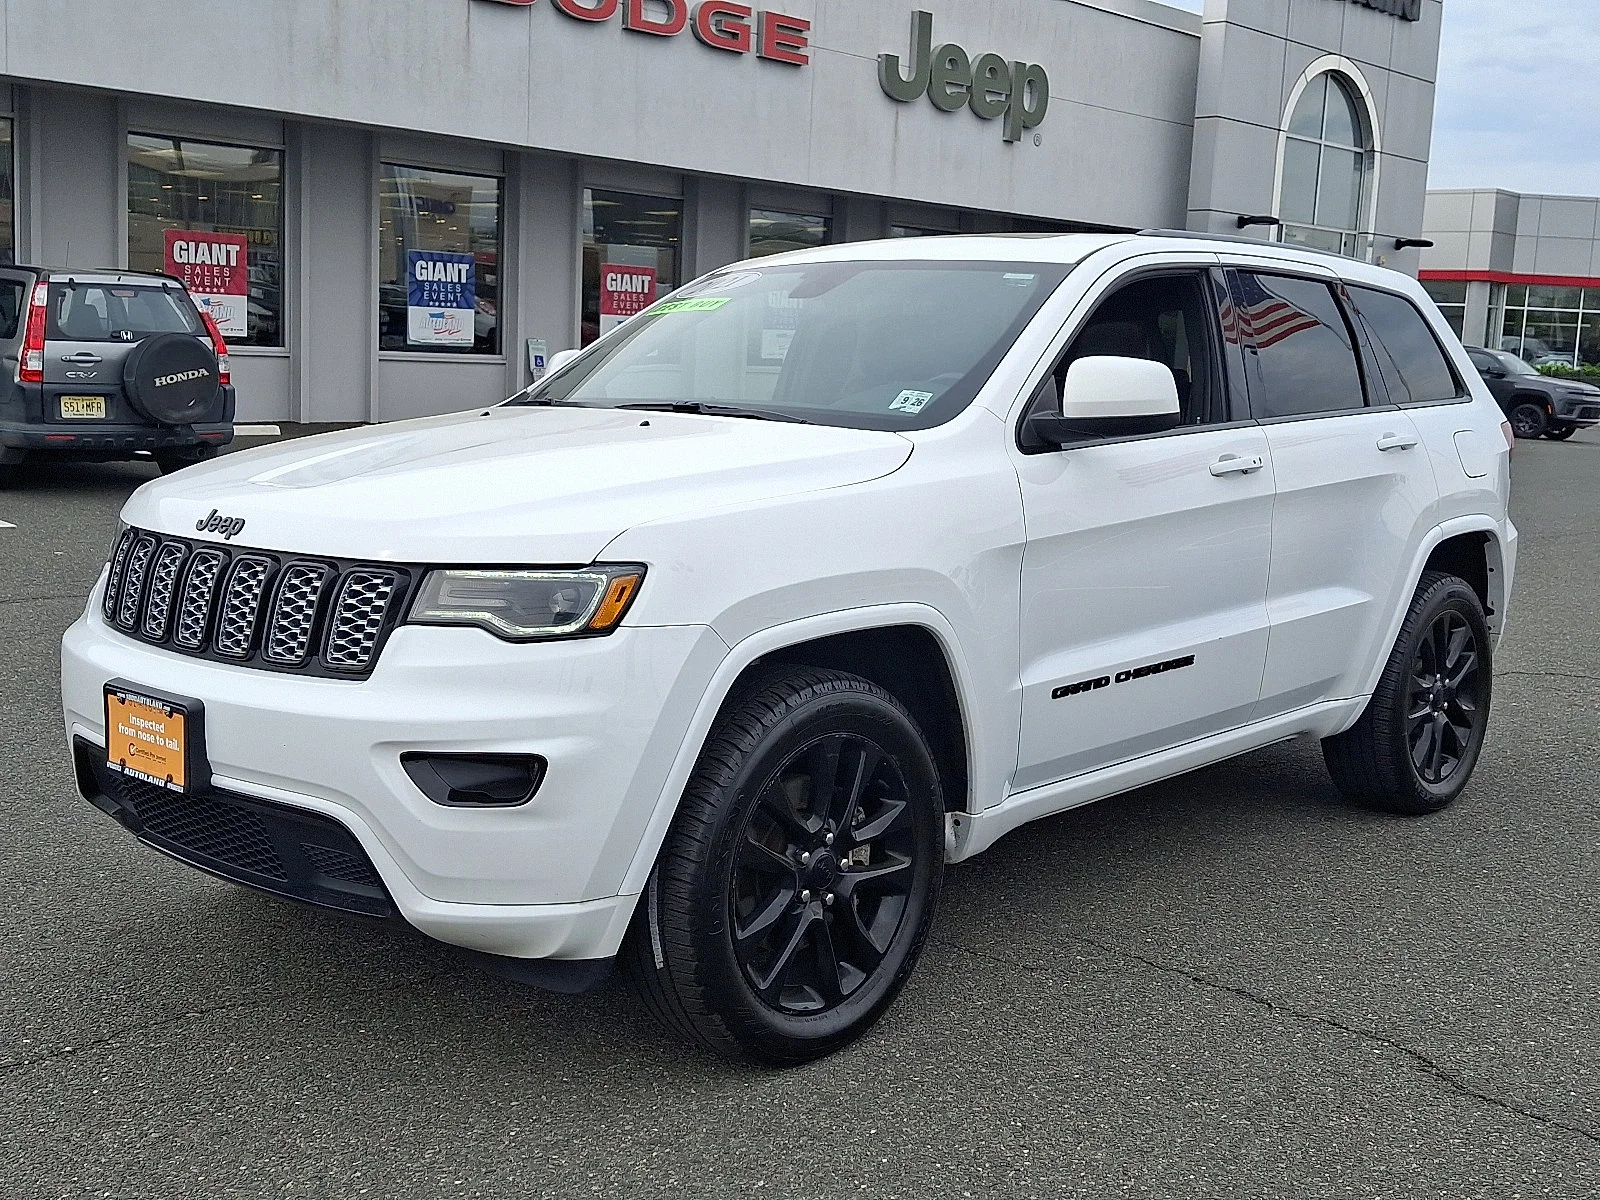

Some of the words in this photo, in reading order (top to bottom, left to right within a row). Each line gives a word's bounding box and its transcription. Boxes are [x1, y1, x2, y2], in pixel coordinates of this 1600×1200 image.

[478, 0, 811, 65] DGE
[878, 10, 1049, 143] Jeep
[173, 240, 240, 267] GIANT
[184, 265, 230, 276] SALES
[415, 260, 470, 283] GIANT
[184, 276, 231, 286] EVENT
[424, 282, 461, 292] SALES
[606, 272, 652, 293] GIANT
[424, 291, 461, 301] EVENT
[613, 292, 645, 302] SALES
[613, 301, 645, 310] EVENT
[65, 371, 98, 379] CR-V
[154, 367, 210, 387] HONDA
[195, 508, 246, 540] Jeep
[1051, 675, 1111, 699] GRAND
[129, 713, 165, 733] Inspected
[118, 722, 136, 738] from
[137, 730, 155, 744] nose
[156, 735, 165, 747] to
[165, 737, 180, 752] tail.
[124, 767, 165, 787] AUTOLAND
